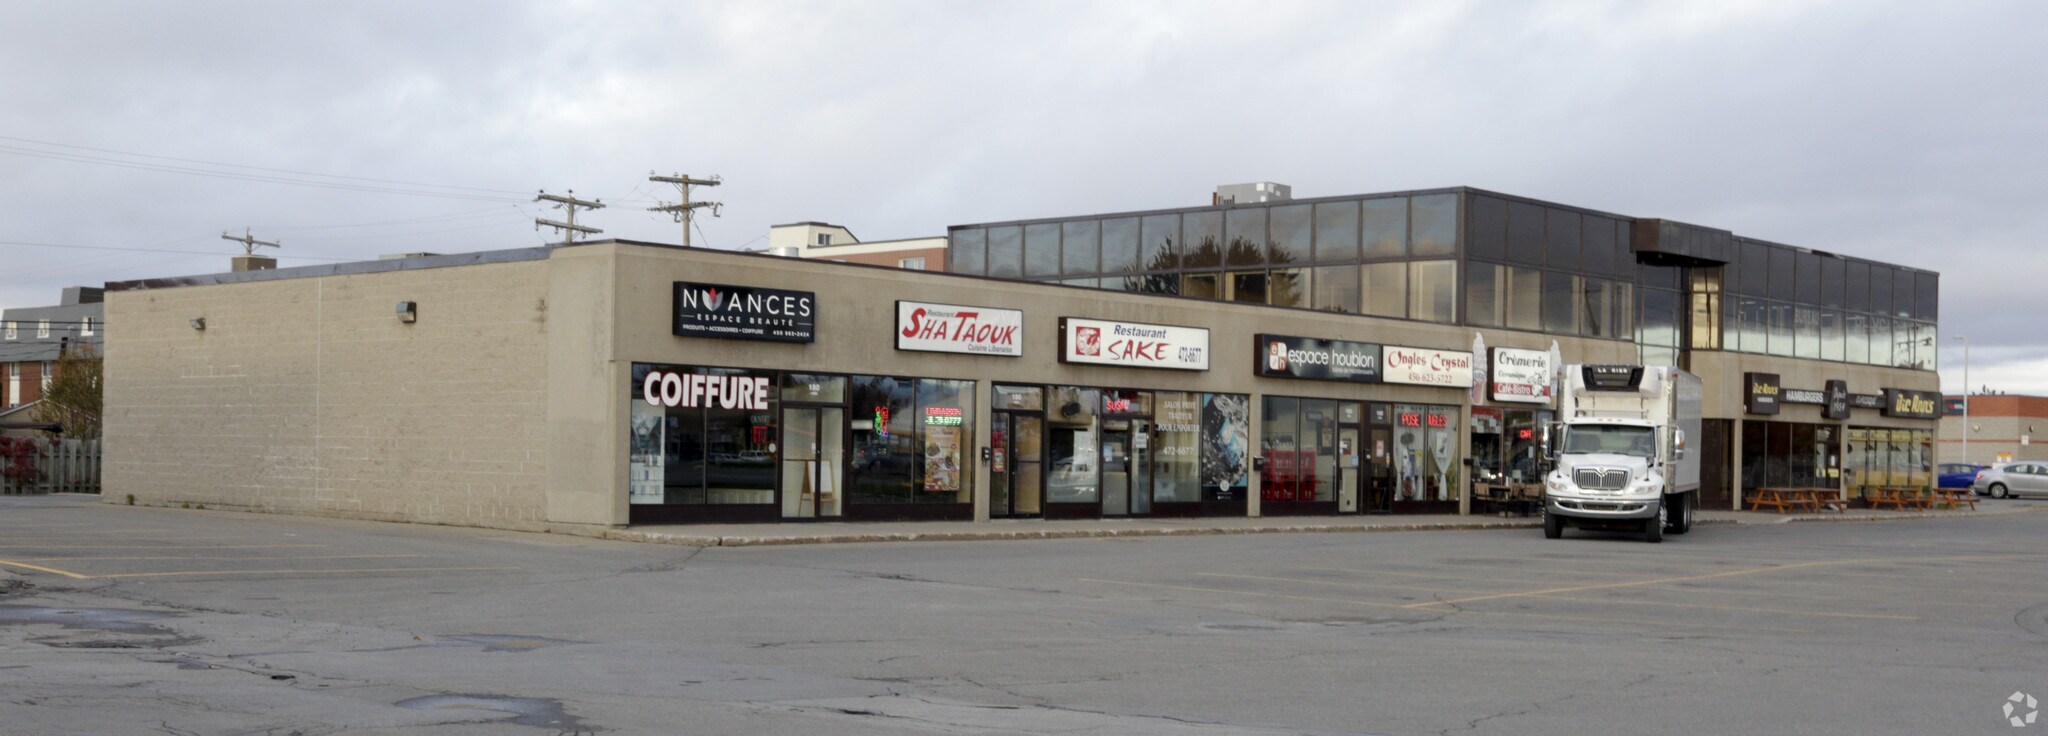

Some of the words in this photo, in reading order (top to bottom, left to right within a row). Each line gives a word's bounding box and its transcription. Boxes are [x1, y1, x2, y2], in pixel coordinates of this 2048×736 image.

[927, 309, 955, 318] Restaurant
[697, 314, 741, 323] ESPACE
[749, 317, 793, 327] BEAUTÉ
[1114, 324, 1167, 339] Restaurant
[968, 344, 987, 352] Cuisine
[1108, 339, 1172, 362] SAKE
[1178, 346, 1202, 363] 472-6677
[1288, 349, 1329, 367] espace
[1332, 349, 1374, 368] houblon
[1388, 350, 1427, 370] Ongles
[1431, 353, 1469, 371] Crystal
[1498, 351, 1546, 369] Crèmerie
[643, 371, 769, 410] COIFFURE
[808, 383, 820, 391] 180
[1786, 390, 1823, 403] HAMBURGERS
[1402, 413, 1420, 426] POSE
[1163, 447, 1194, 456] 472-6677
